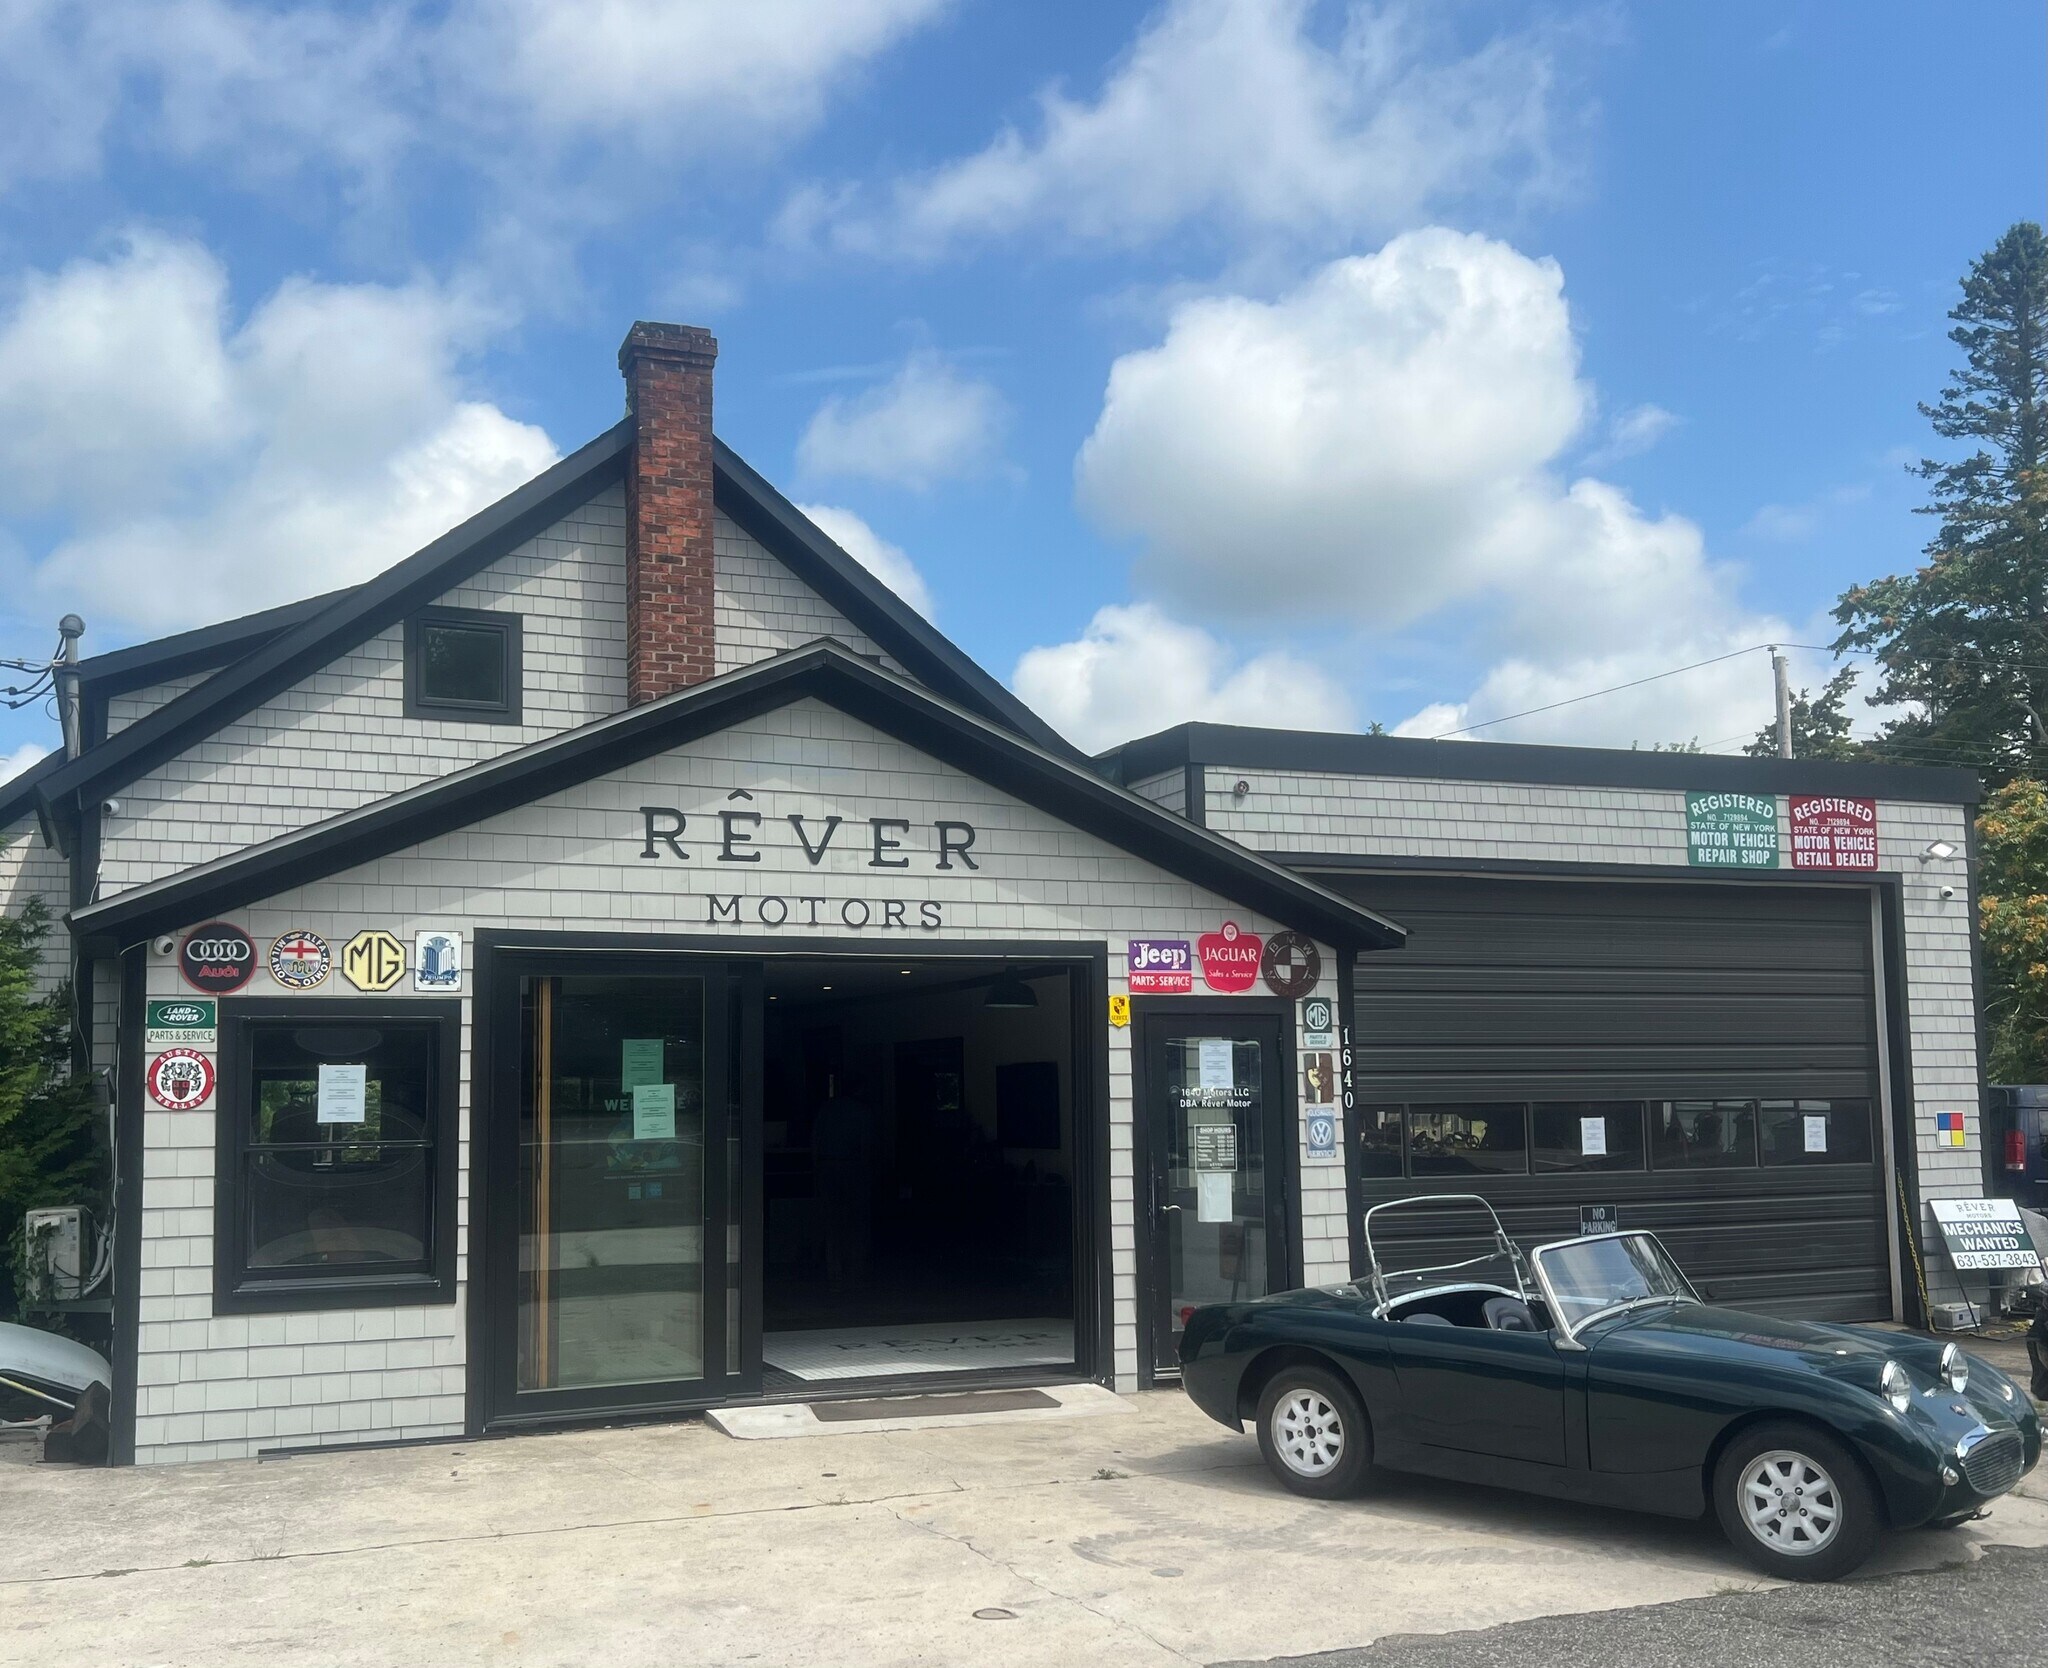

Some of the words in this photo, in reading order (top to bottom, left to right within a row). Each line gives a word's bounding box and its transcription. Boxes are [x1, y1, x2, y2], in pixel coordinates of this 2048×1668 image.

[1690, 794, 1774, 819] REGISTERED
[1793, 798, 1873, 822] REGISTERED
[639, 788, 979, 870] RÊVER
[1690, 821, 1716, 830] STATE
[1719, 823, 1730, 831] OF
[1733, 823, 1751, 831] NEW
[1753, 824, 1776, 832] YORK
[1793, 826, 1818, 834] STATE
[1834, 827, 1851, 835] NEW
[1853, 827, 1875, 835] YORK
[1690, 831, 1729, 846] MOTOR
[1733, 832, 1776, 848] VEHICLE
[1794, 835, 1831, 850] MOTOR
[1833, 836, 1875, 851] VEHICLE
[1697, 848, 1737, 863] REPAIR
[1741, 849, 1770, 864] SHOP
[1796, 851, 1833, 866] RETAIL
[1836, 852, 1874, 867] DEALER
[705, 893, 942, 930] MOTORS
[303, 933, 327, 952] ALFA
[1268, 935, 1314, 956] BMW
[272, 939, 287, 978] MILANO
[350, 937, 400, 984] MG
[1203, 947, 1258, 963] JAGUAR
[198, 964, 240, 978] Audi
[1208, 969, 1224, 978] Sales
[1231, 969, 1254, 979] Service
[1309, 1005, 1327, 1027] MG
[150, 1030, 174, 1040] PARTS
[175, 1031, 182, 1040] &
[182, 1030, 213, 1041] SERVICE
[160, 1049, 205, 1063] AUSTIN
[1181, 1088, 1201, 1097] 1640
[1203, 1087, 1233, 1097] Motors
[1234, 1087, 1250, 1097] LLC
[155, 1094, 205, 1109] HEALEY
[1226, 1099, 1252, 1108] Motor
[1592, 1207, 1606, 1220] NO
[1582, 1220, 1616, 1234] PARKING
[1942, 1221, 2025, 1236] MECHANICS
[1959, 1236, 2020, 1251] WANTED
[1956, 1252, 2037, 1268] 631-537-3843
